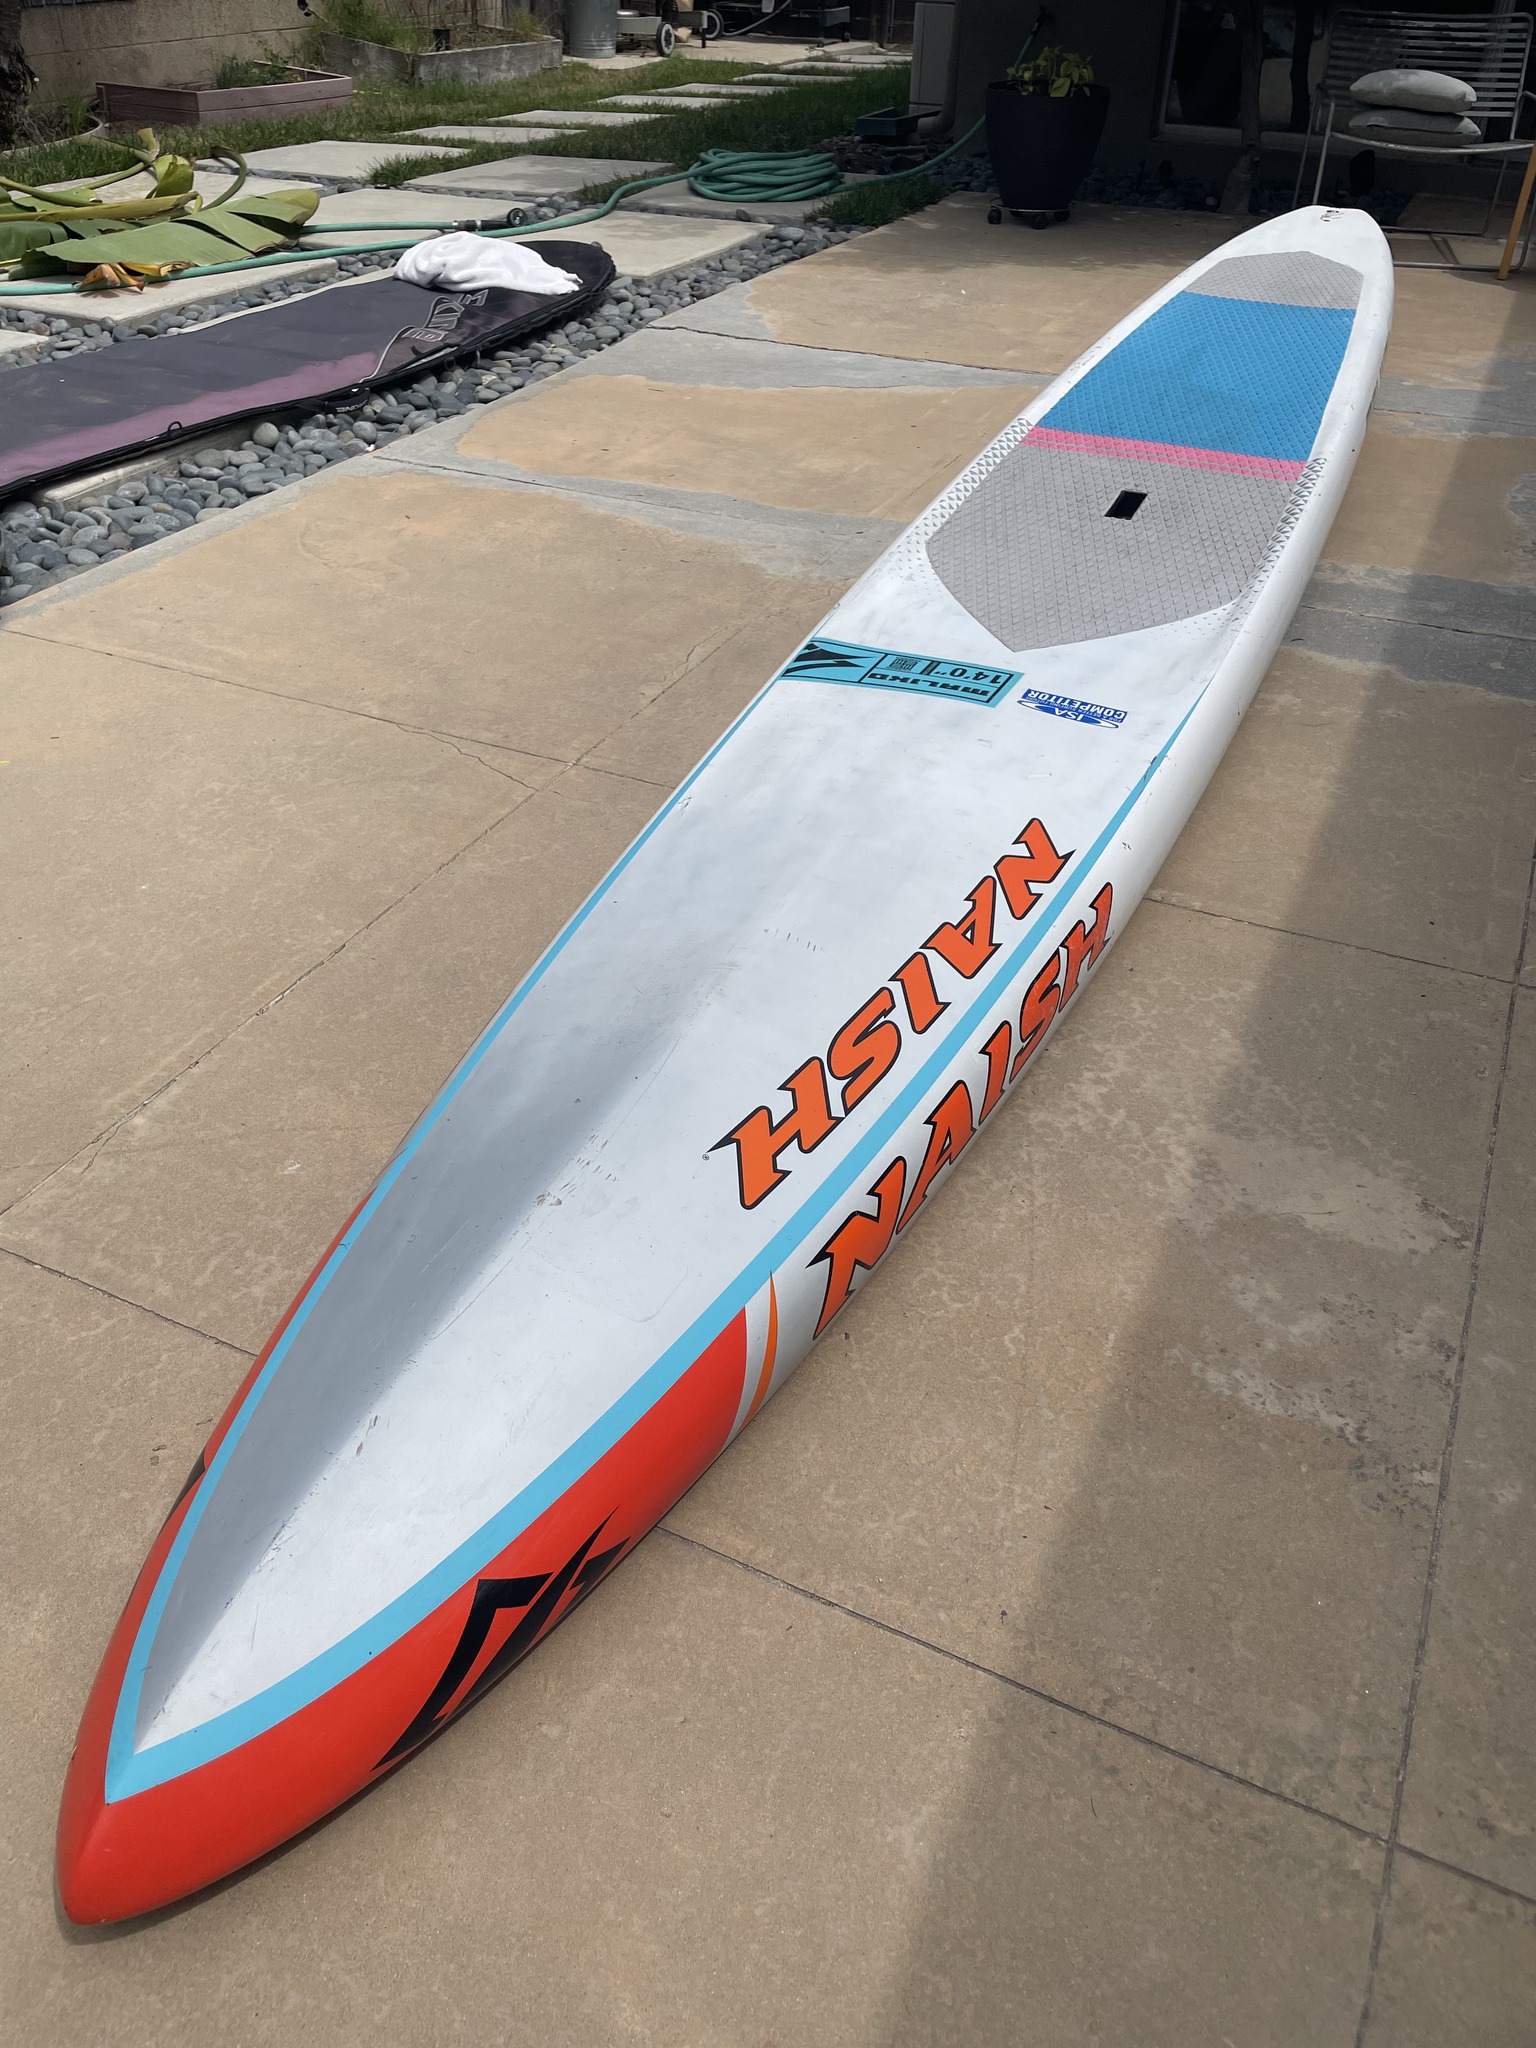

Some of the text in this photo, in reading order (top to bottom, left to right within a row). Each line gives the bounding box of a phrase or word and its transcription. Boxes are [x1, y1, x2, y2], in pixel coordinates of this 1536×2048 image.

[867, 672, 992, 696] MALIKO
[1028, 690, 1126, 720] COMPETITOR
[1054, 707, 1085, 721] ISA
[706, 818, 1077, 1210] NAISH
[805, 881, 1115, 1341] NAISH
